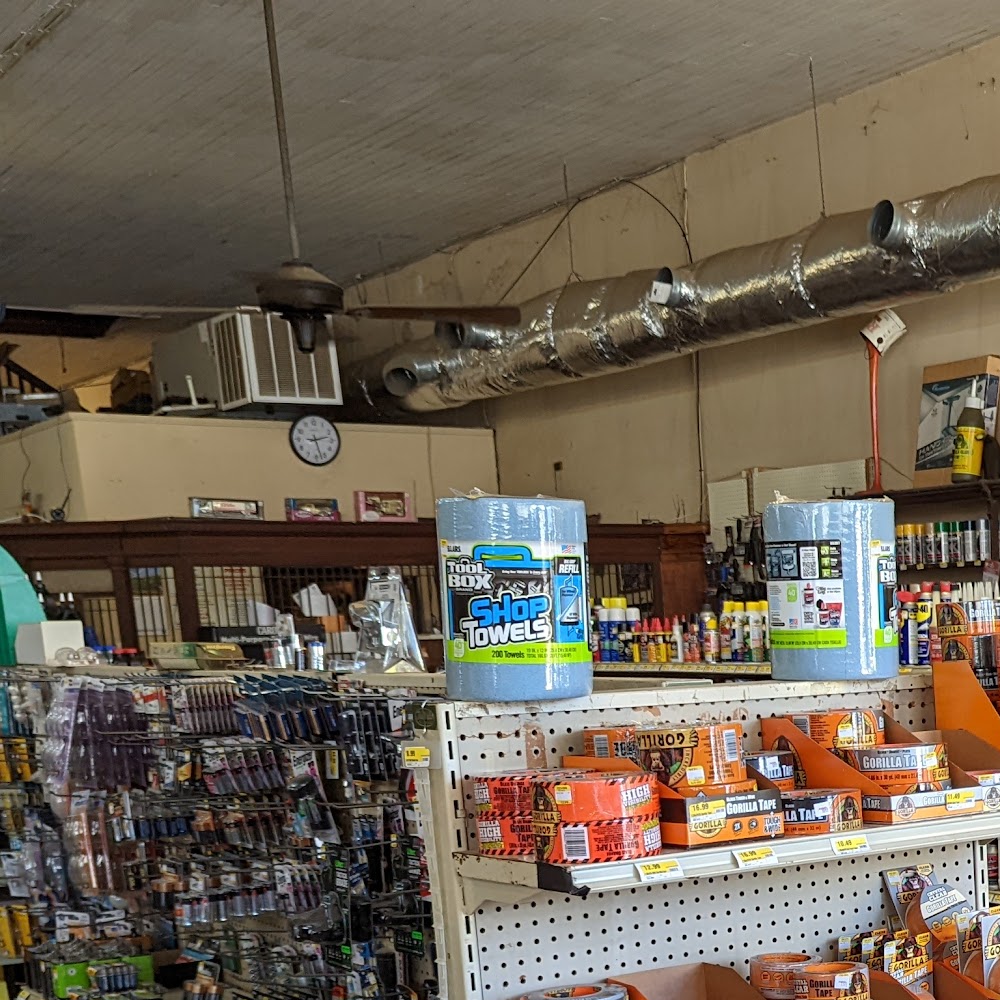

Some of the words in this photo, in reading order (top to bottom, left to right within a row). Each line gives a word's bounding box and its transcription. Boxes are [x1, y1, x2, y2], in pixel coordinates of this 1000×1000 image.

[447, 561, 487, 574] TOOL
[559, 564, 580, 573] REFILL
[449, 574, 493, 590] BOX
[471, 595, 548, 627] SHOP
[462, 618, 550, 648] TOWELS
[504, 649, 525, 658] Towels
[637, 731, 685, 748] GORILLA
[863, 755, 902, 769] GORILLA
[621, 784, 649, 801] HIGH
[692, 803, 709, 812] 16.99
[726, 801, 757, 815] GORILLA
[758, 799, 776, 811] TAPE
[693, 820, 723, 829] GORILLA
[764, 816, 781, 825] TOUGH
[837, 821, 861, 831] GORILLA
[643, 863, 660, 871] 12.99
[894, 958, 926, 970] GORILLA
[815, 987, 832, 997] TAPE
